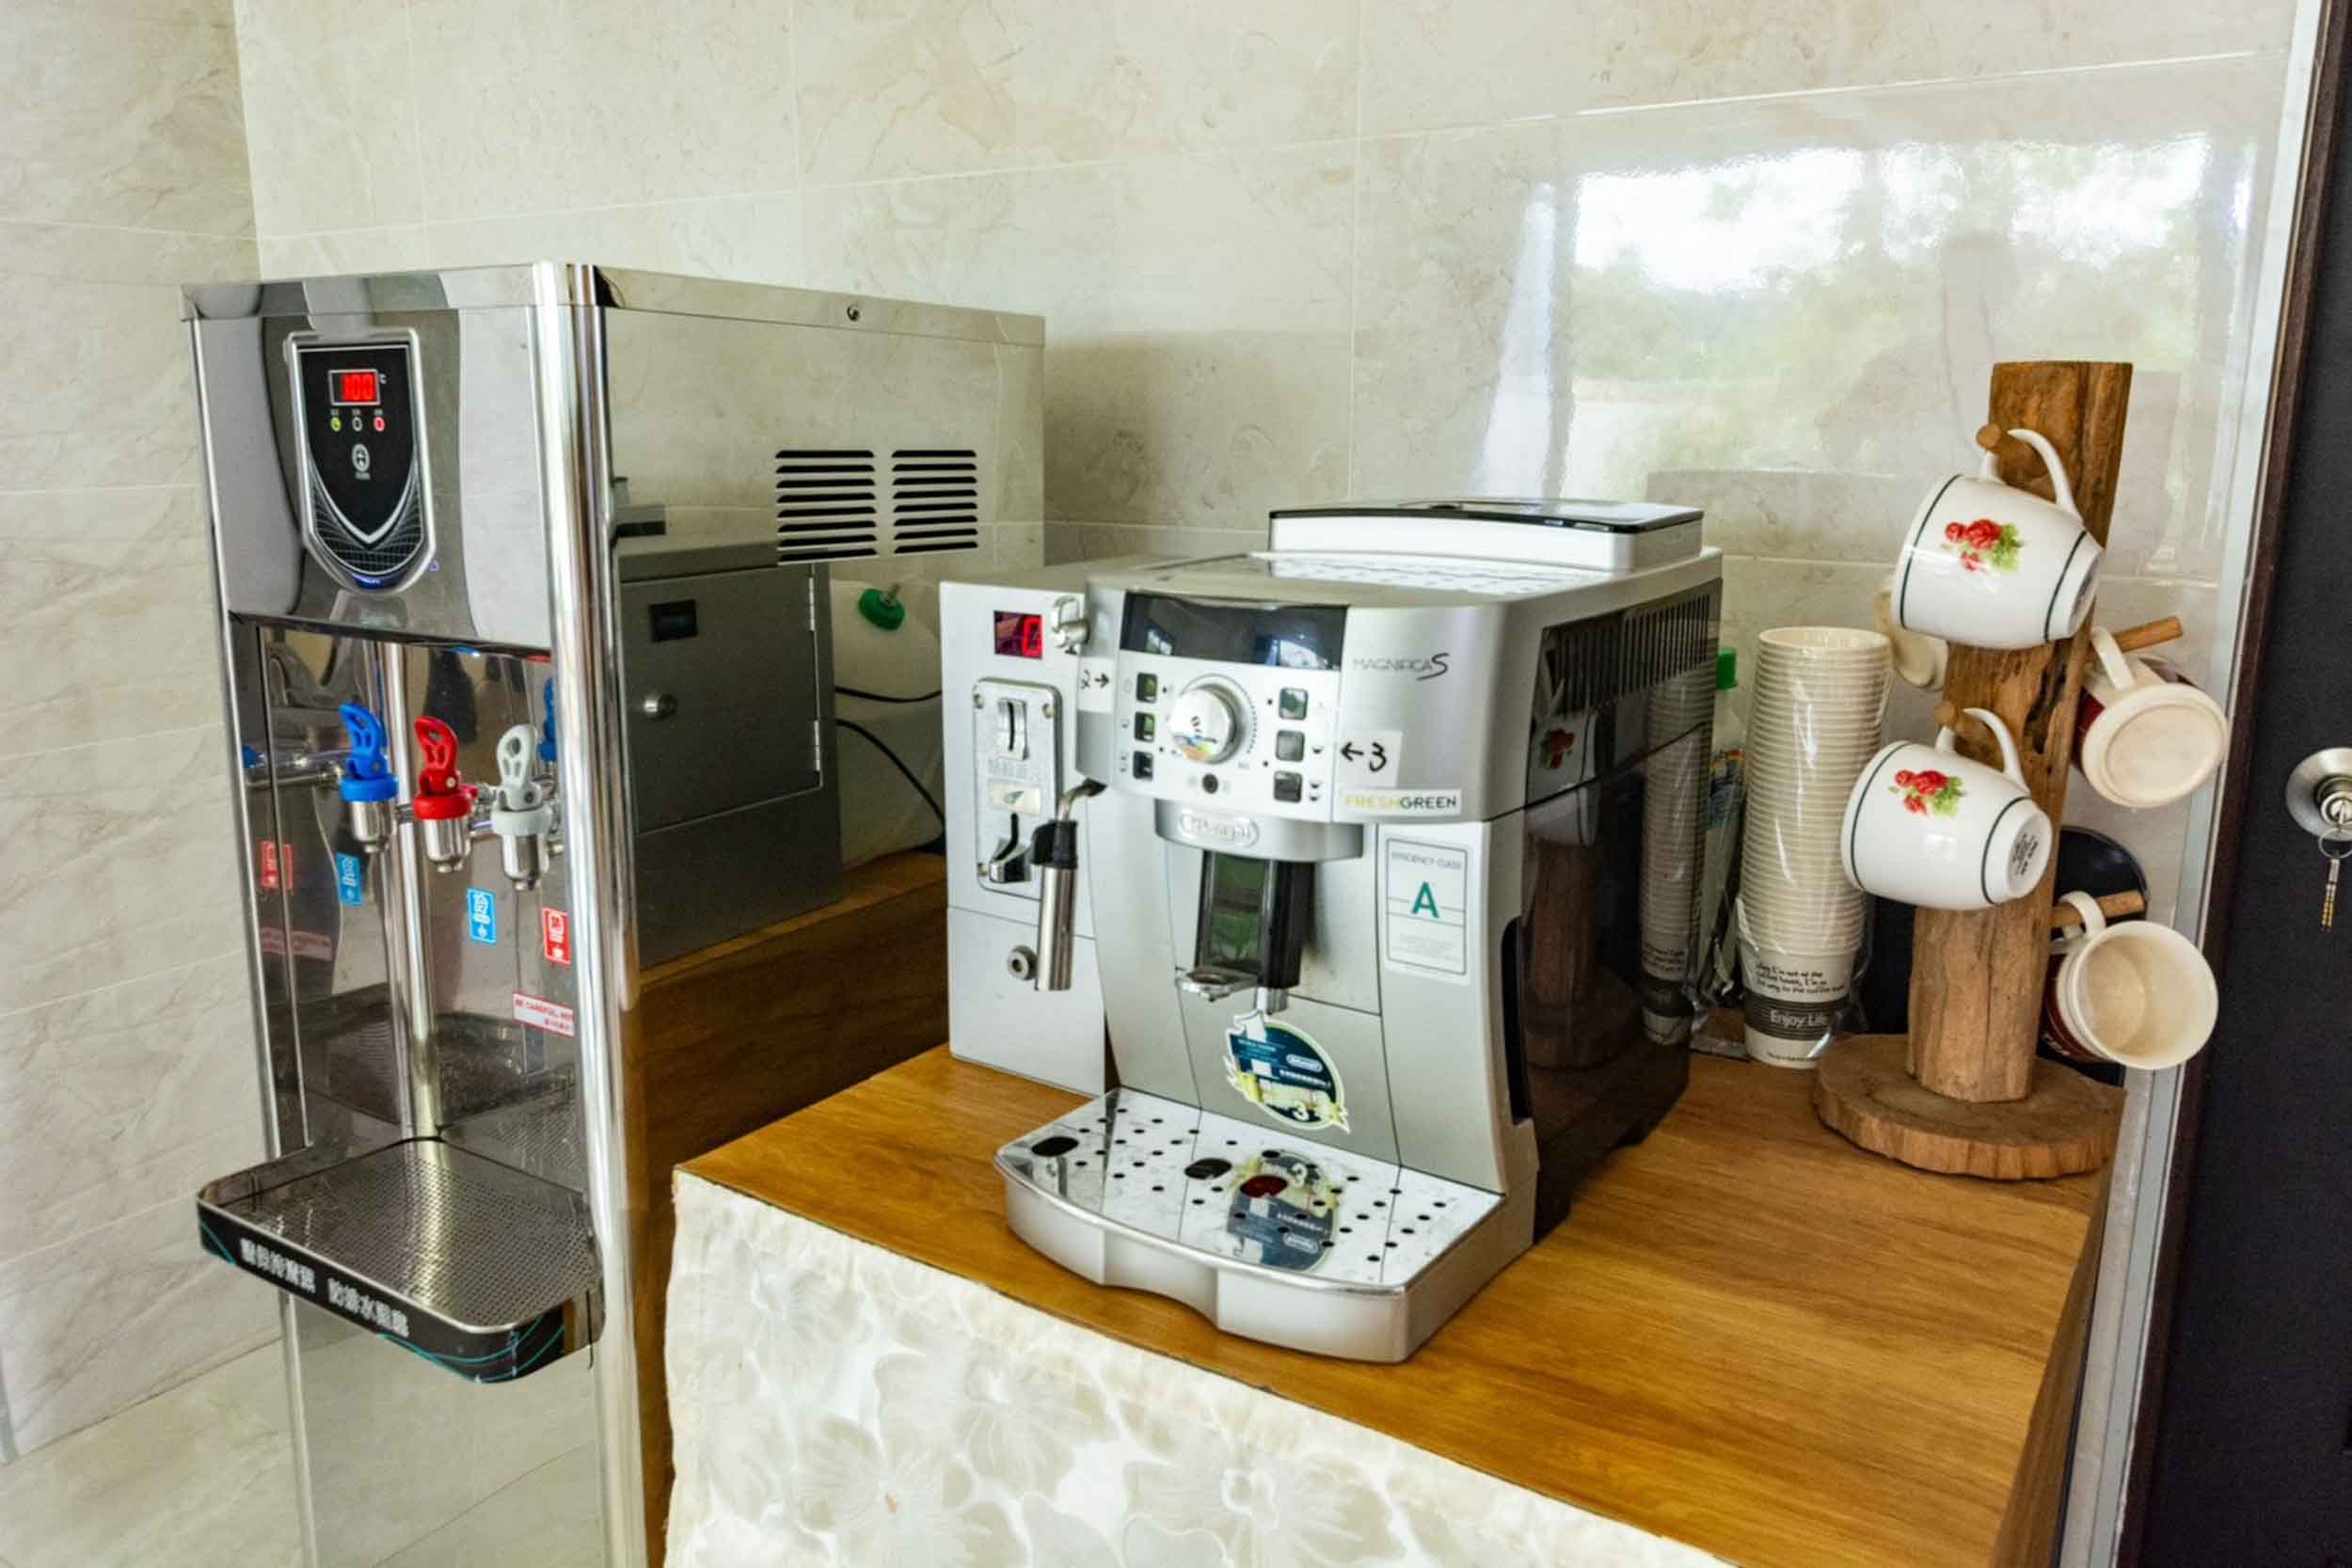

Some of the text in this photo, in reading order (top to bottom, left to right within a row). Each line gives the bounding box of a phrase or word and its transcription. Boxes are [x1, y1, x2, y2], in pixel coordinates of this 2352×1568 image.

[1023, 616, 1041, 657] 0
[1368, 741, 1388, 772] 3
[1410, 880, 1440, 919] A
